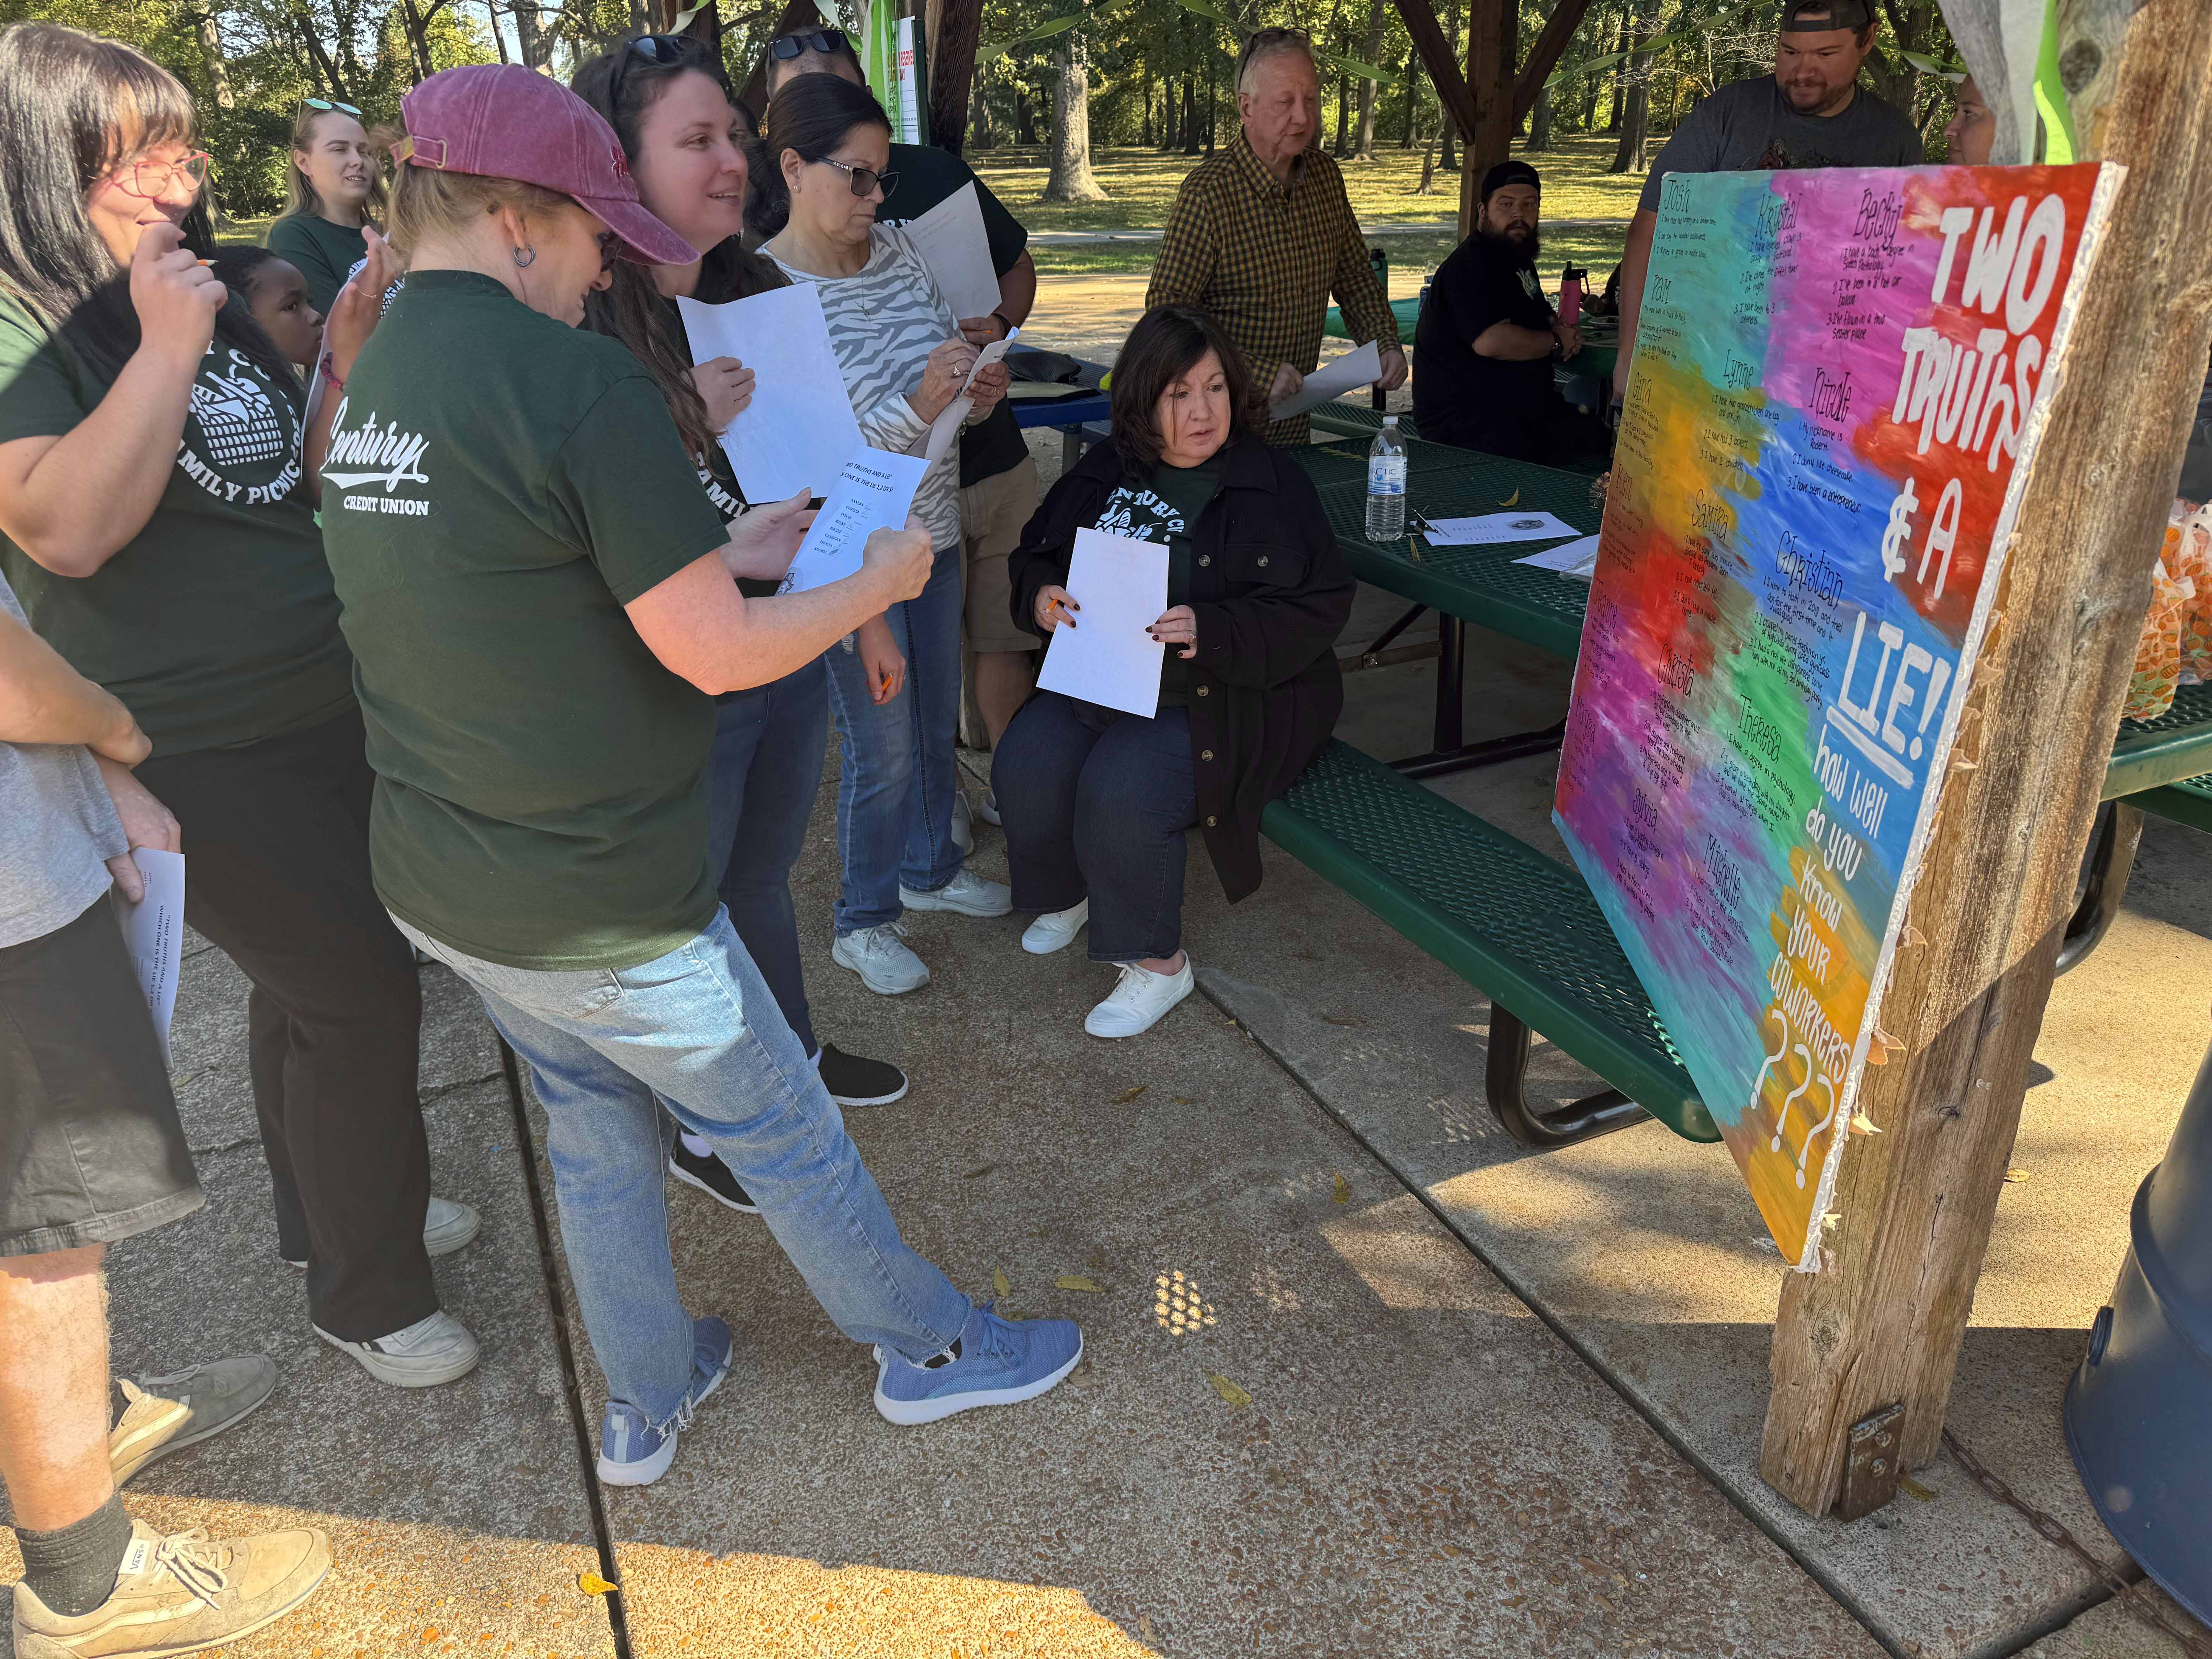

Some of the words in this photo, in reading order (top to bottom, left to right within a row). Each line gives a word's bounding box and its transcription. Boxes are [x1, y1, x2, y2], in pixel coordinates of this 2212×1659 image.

[1664, 179, 1690, 213] Josh
[1853, 188, 1901, 251] Becky
[1931, 194, 2065, 336] TWO
[1723, 349, 1753, 390] Lynne
[1633, 372, 1652, 404] Gina
[1802, 422, 1808, 441] My
[1809, 426, 1835, 440] nickname
[1837, 433, 1843, 441] is
[177, 439, 243, 502] MILY
[246, 458, 301, 505] PICNIC
[1816, 459, 1825, 470] like
[1105, 487, 1180, 518] ENTURY
[1796, 477, 1808, 493] have
[1808, 483, 1821, 495] been
[1822, 489, 1827, 498] a
[343, 495, 378, 512] CREDIT
[380, 498, 430, 516] UNION
[1882, 477, 1919, 581] &
[1916, 477, 1962, 599] A
[1774, 596, 1783, 611] for
[1783, 603, 1791, 613] the
[1792, 605, 1802, 620] first
[1817, 625, 1826, 637] and
[1782, 587, 1786, 596] to
[1807, 600, 1819, 617] 2018
[1820, 613, 1831, 624] and
[1831, 617, 1843, 633] tried
[1757, 639, 1767, 652] had
[1771, 649, 1779, 660] real
[1778, 627, 1784, 641] my
[1784, 632, 1797, 649] pants
[1797, 638, 1818, 659] freshman
[1760, 656, 1769, 666] with
[1769, 661, 1776, 670] me
[1838, 611, 1953, 761] LIE!
[1733, 735, 1742, 752] have
[1749, 752, 1762, 771] degree
[1764, 765, 1769, 776] in
[1731, 773, 1737, 782] we
[1738, 777, 1746, 791] have
[1813, 724, 1845, 804] how
[1850, 769, 1889, 840] well
[1768, 822, 1774, 832] I
[1806, 795, 1827, 843] do
[1702, 919, 1706, 928] to
[1705, 905, 1709, 914] in
[1691, 921, 1699, 932] and
[130, 1549, 144, 1570] VANS
